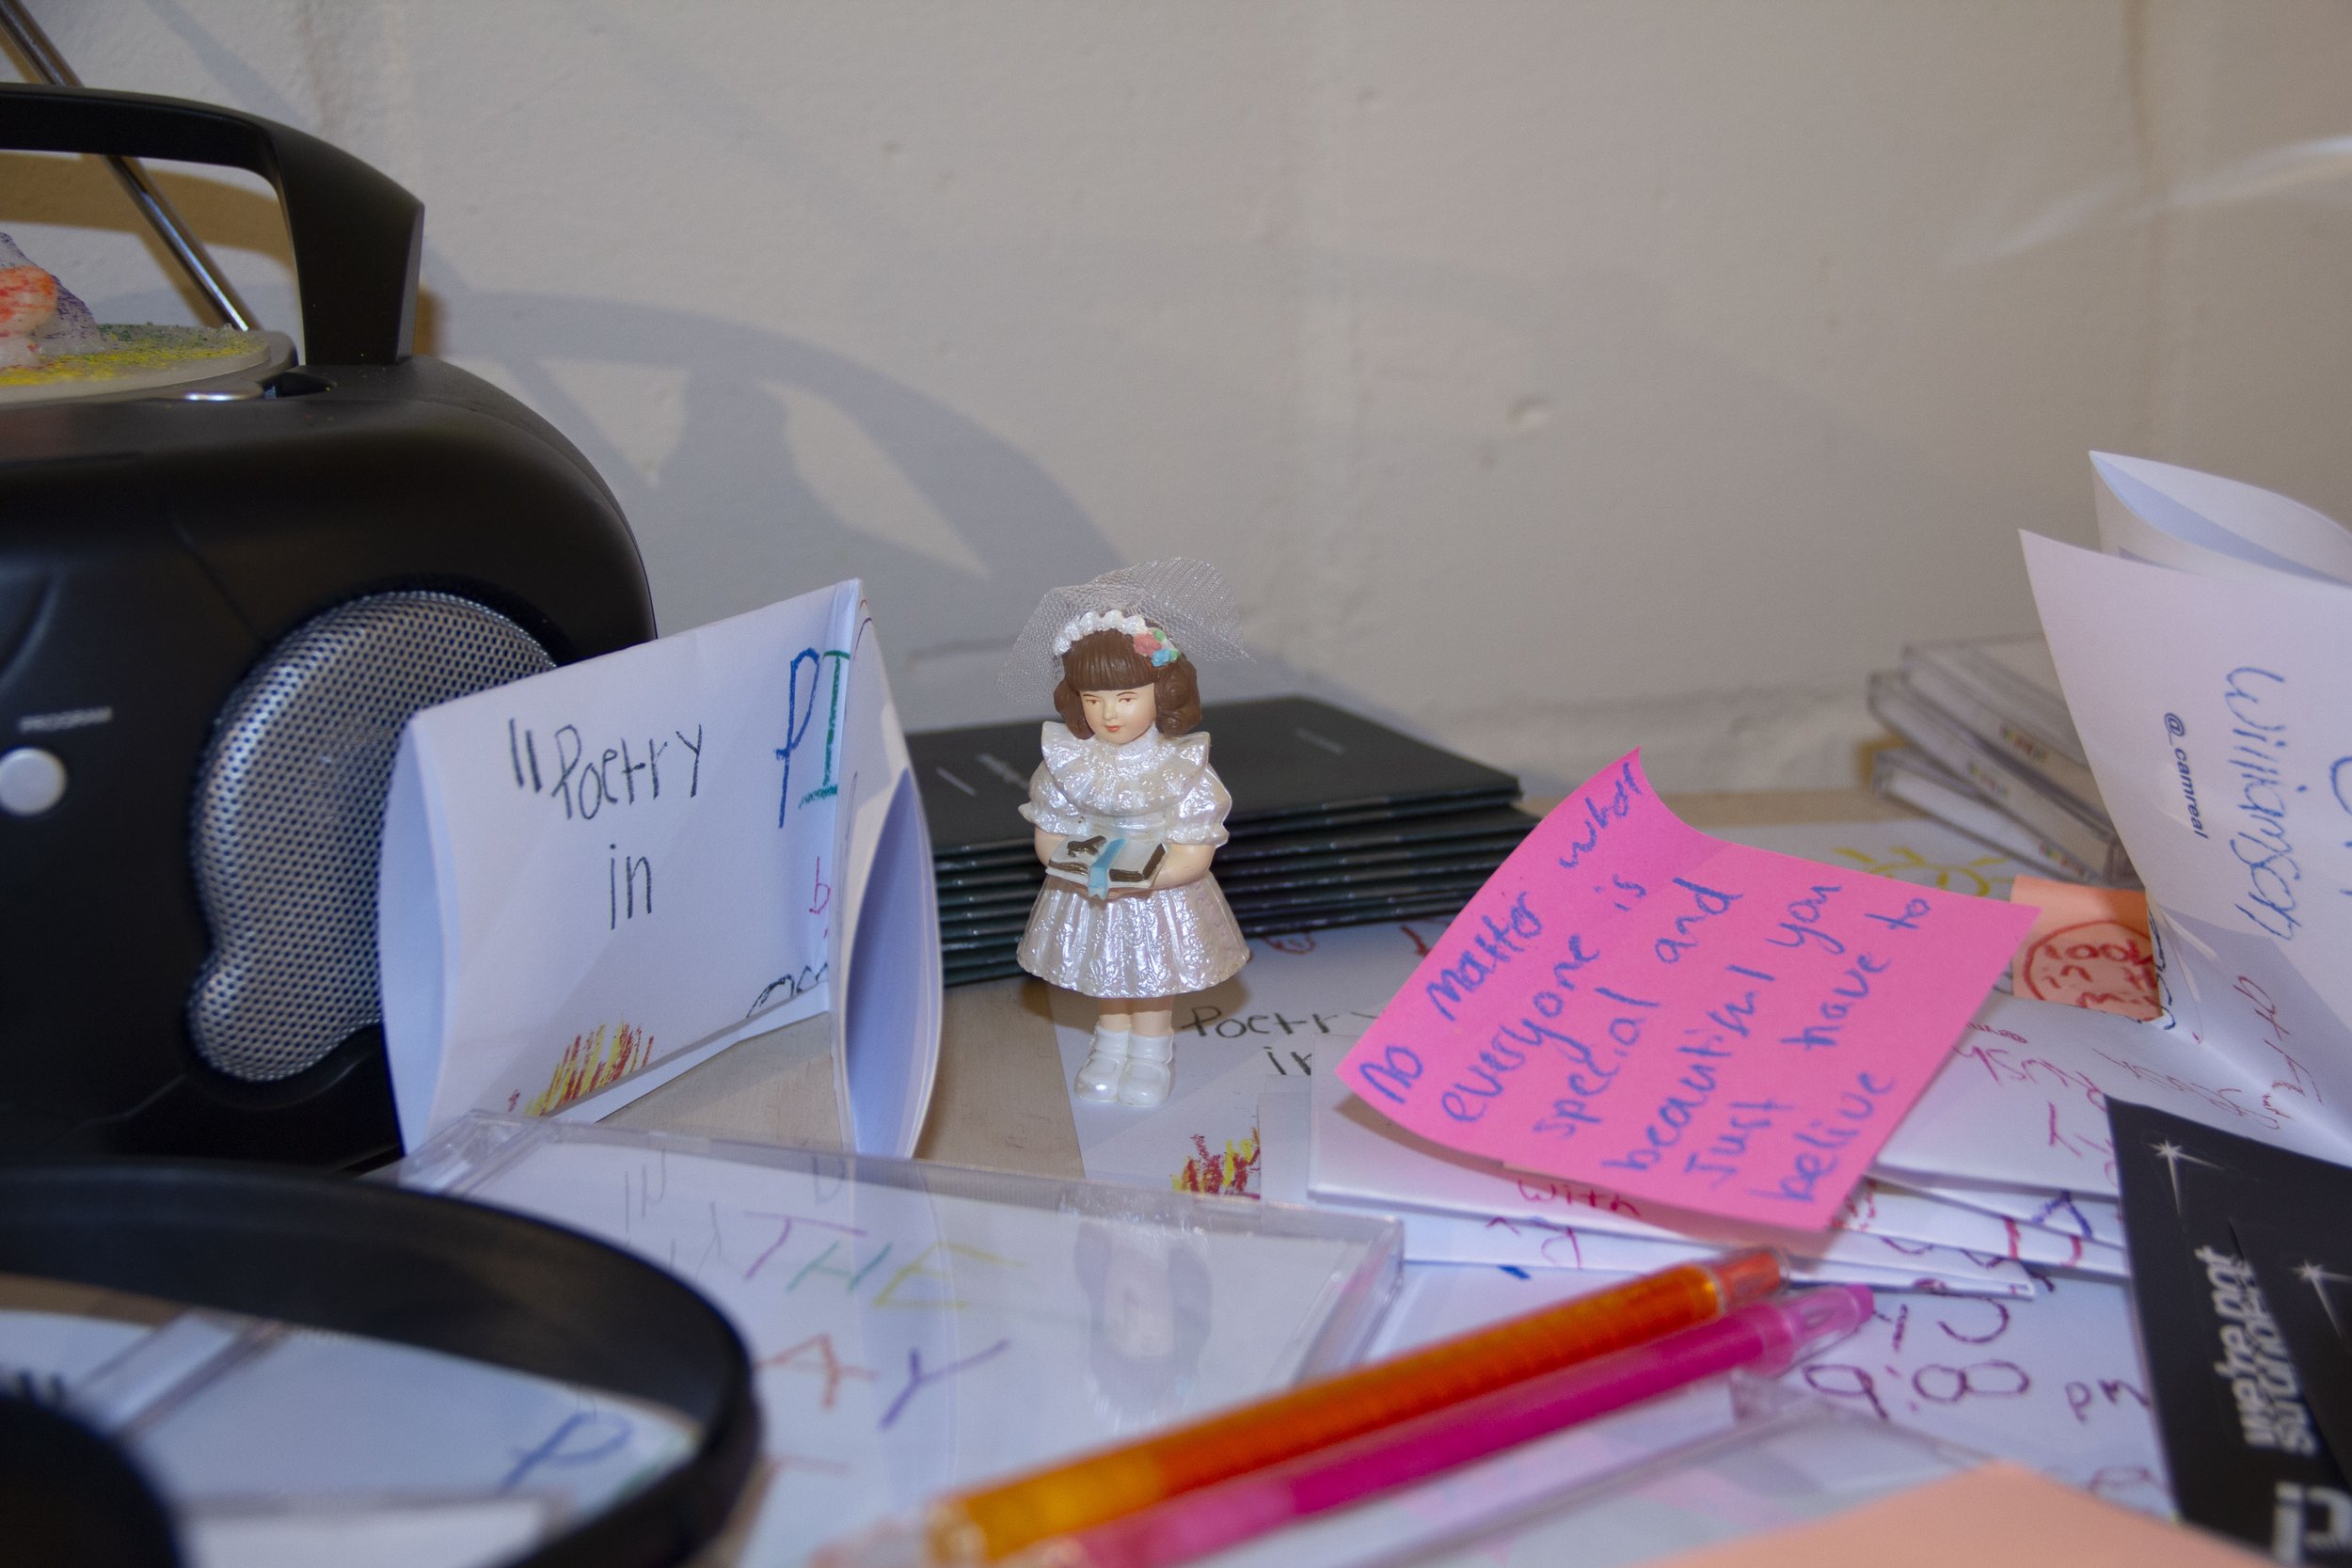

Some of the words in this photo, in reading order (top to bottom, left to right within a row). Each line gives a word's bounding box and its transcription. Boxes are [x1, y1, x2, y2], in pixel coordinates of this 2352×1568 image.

[610, 844, 652, 929] in
[1595, 874, 1646, 911] is
[1657, 877, 1742, 963] and
[1767, 885, 1842, 955] you
[1780, 952, 1889, 1052] have
[1865, 896, 1931, 931] to
